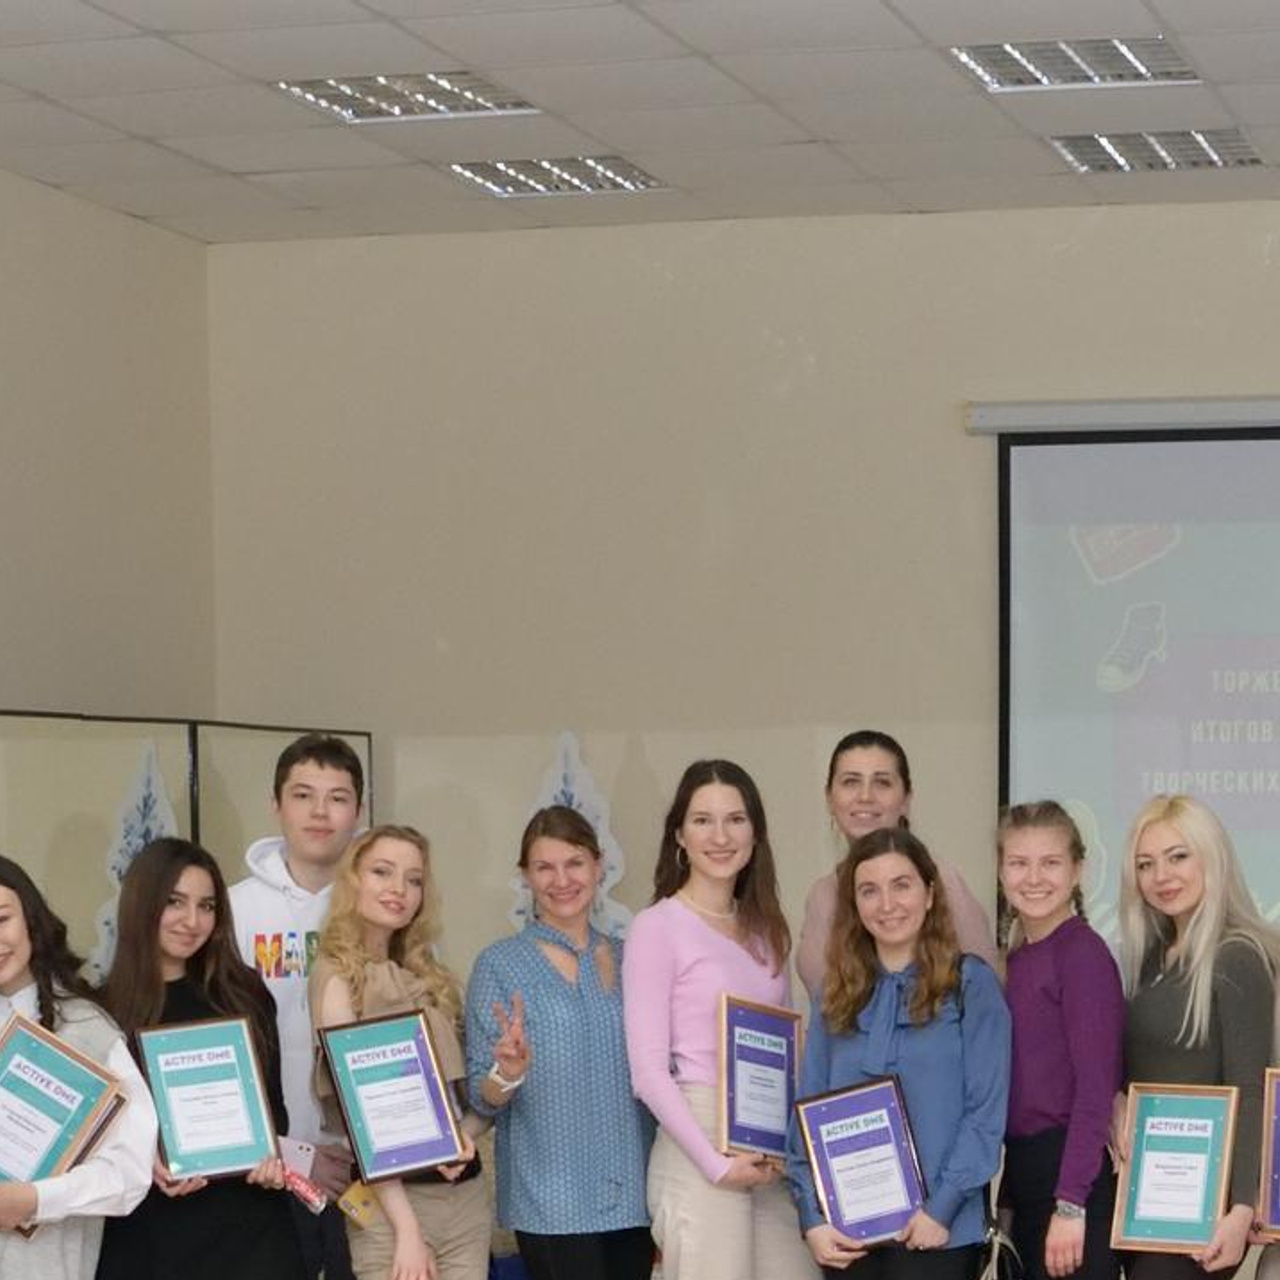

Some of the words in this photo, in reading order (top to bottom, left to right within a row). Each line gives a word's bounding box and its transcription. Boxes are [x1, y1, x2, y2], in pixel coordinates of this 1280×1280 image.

[1191, 719, 1275, 743] ИТОГОВ
[1140, 770, 1280, 793] ТВОРЧЕСКИХ
[738, 1031, 766, 1047] ACTIVE
[164, 1054, 203, 1067] ACTIVE
[350, 1050, 388, 1066] ACTIVE
[14, 1061, 50, 1089] ACTIVE
[825, 1119, 862, 1137] ACTIVE
[1149, 1121, 1184, 1132] ACTIVE
